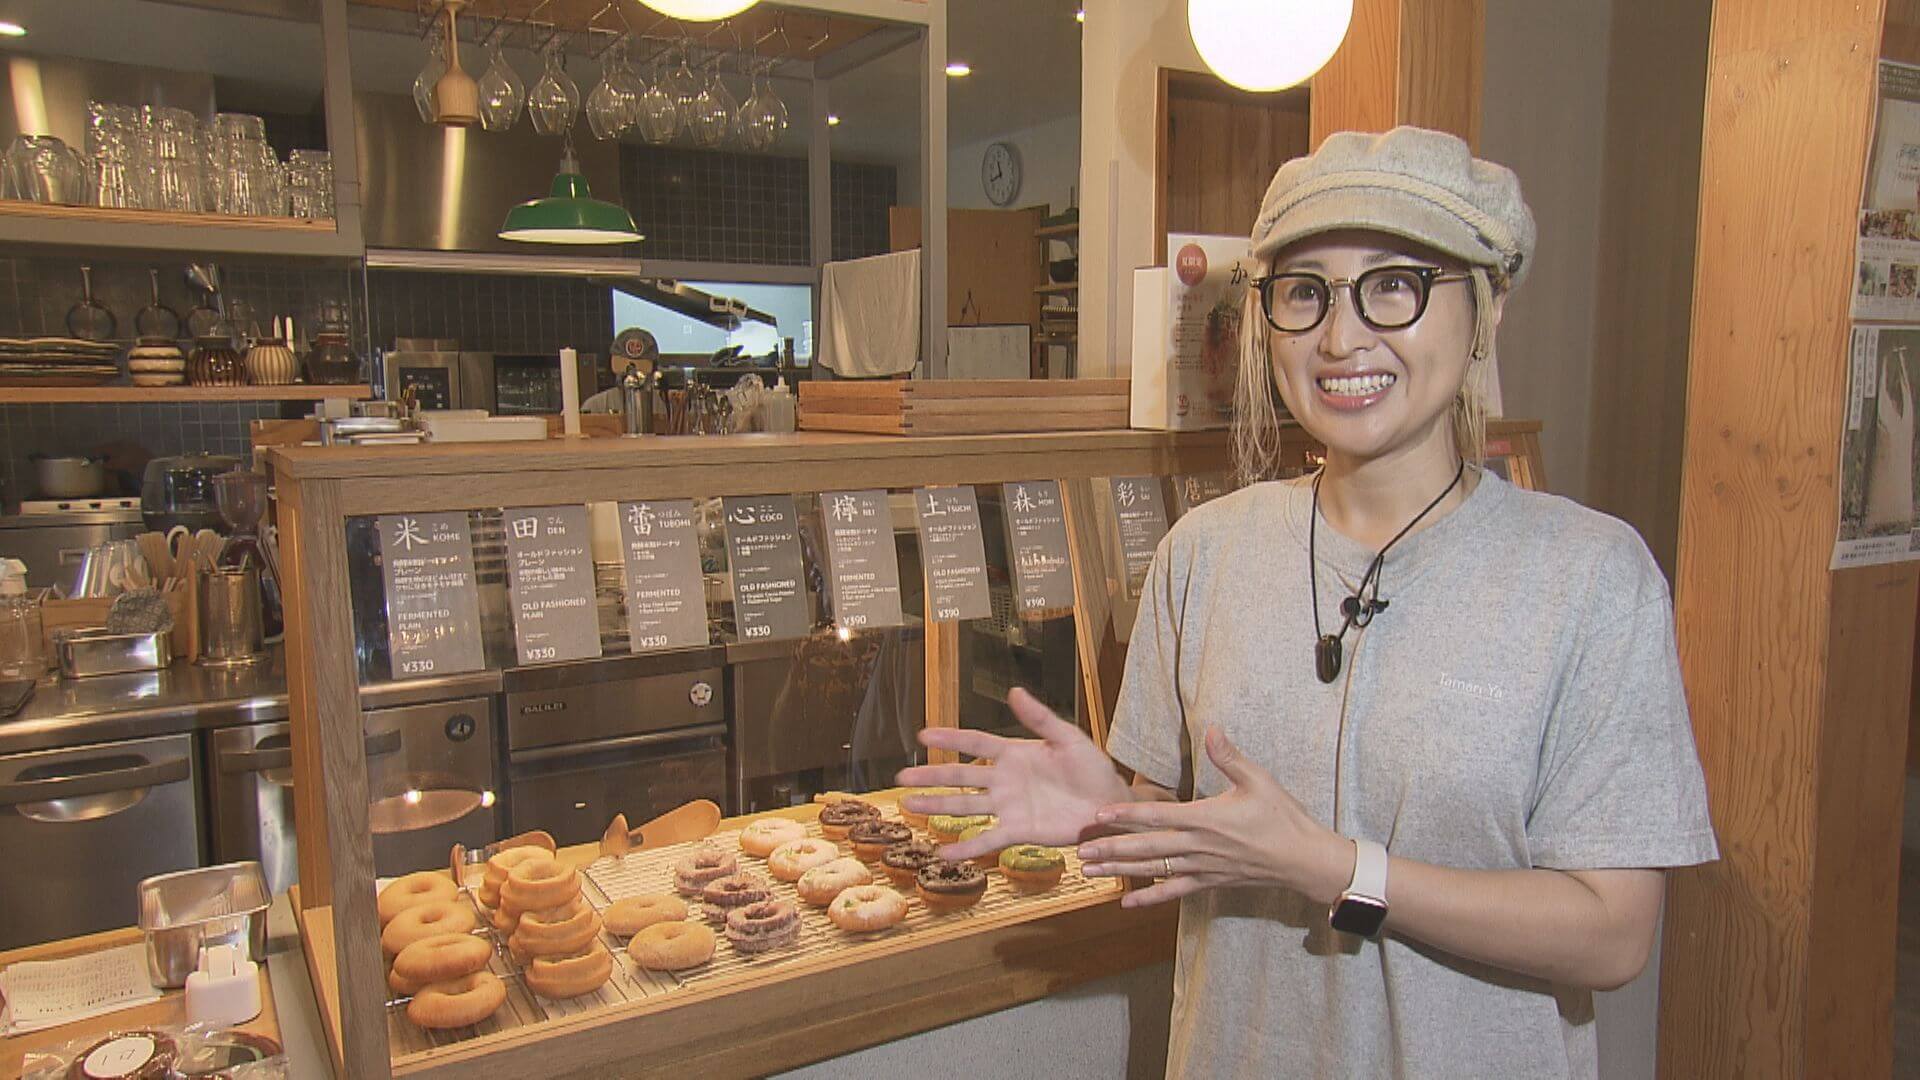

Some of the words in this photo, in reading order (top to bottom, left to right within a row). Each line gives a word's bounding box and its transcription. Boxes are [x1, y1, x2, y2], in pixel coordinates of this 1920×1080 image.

[1012, 485, 1037, 512] 森
[1117, 482, 1136, 508] 彩
[921, 493, 947, 518] 土
[728, 506, 756, 525] 心
[760, 512, 784, 522] COCO
[392, 516, 430, 551] 米
[512, 516, 538, 538] 田
[547, 526, 566, 535] DEN
[432, 532, 460, 542] KOME
[517, 547, 584, 559] オールドファッション
[636, 588, 680, 599] FERMENTED
[740, 583, 755, 592] OLD
[521, 602, 539, 611] OLD
[541, 597, 586, 609] FASHIONED
[398, 608, 450, 621] FERMENTED
[745, 625, 770, 637] ¥330
[640, 635, 667, 647] ¥330
[525, 647, 556, 660] ¥330
[402, 659, 434, 673] ¥330
